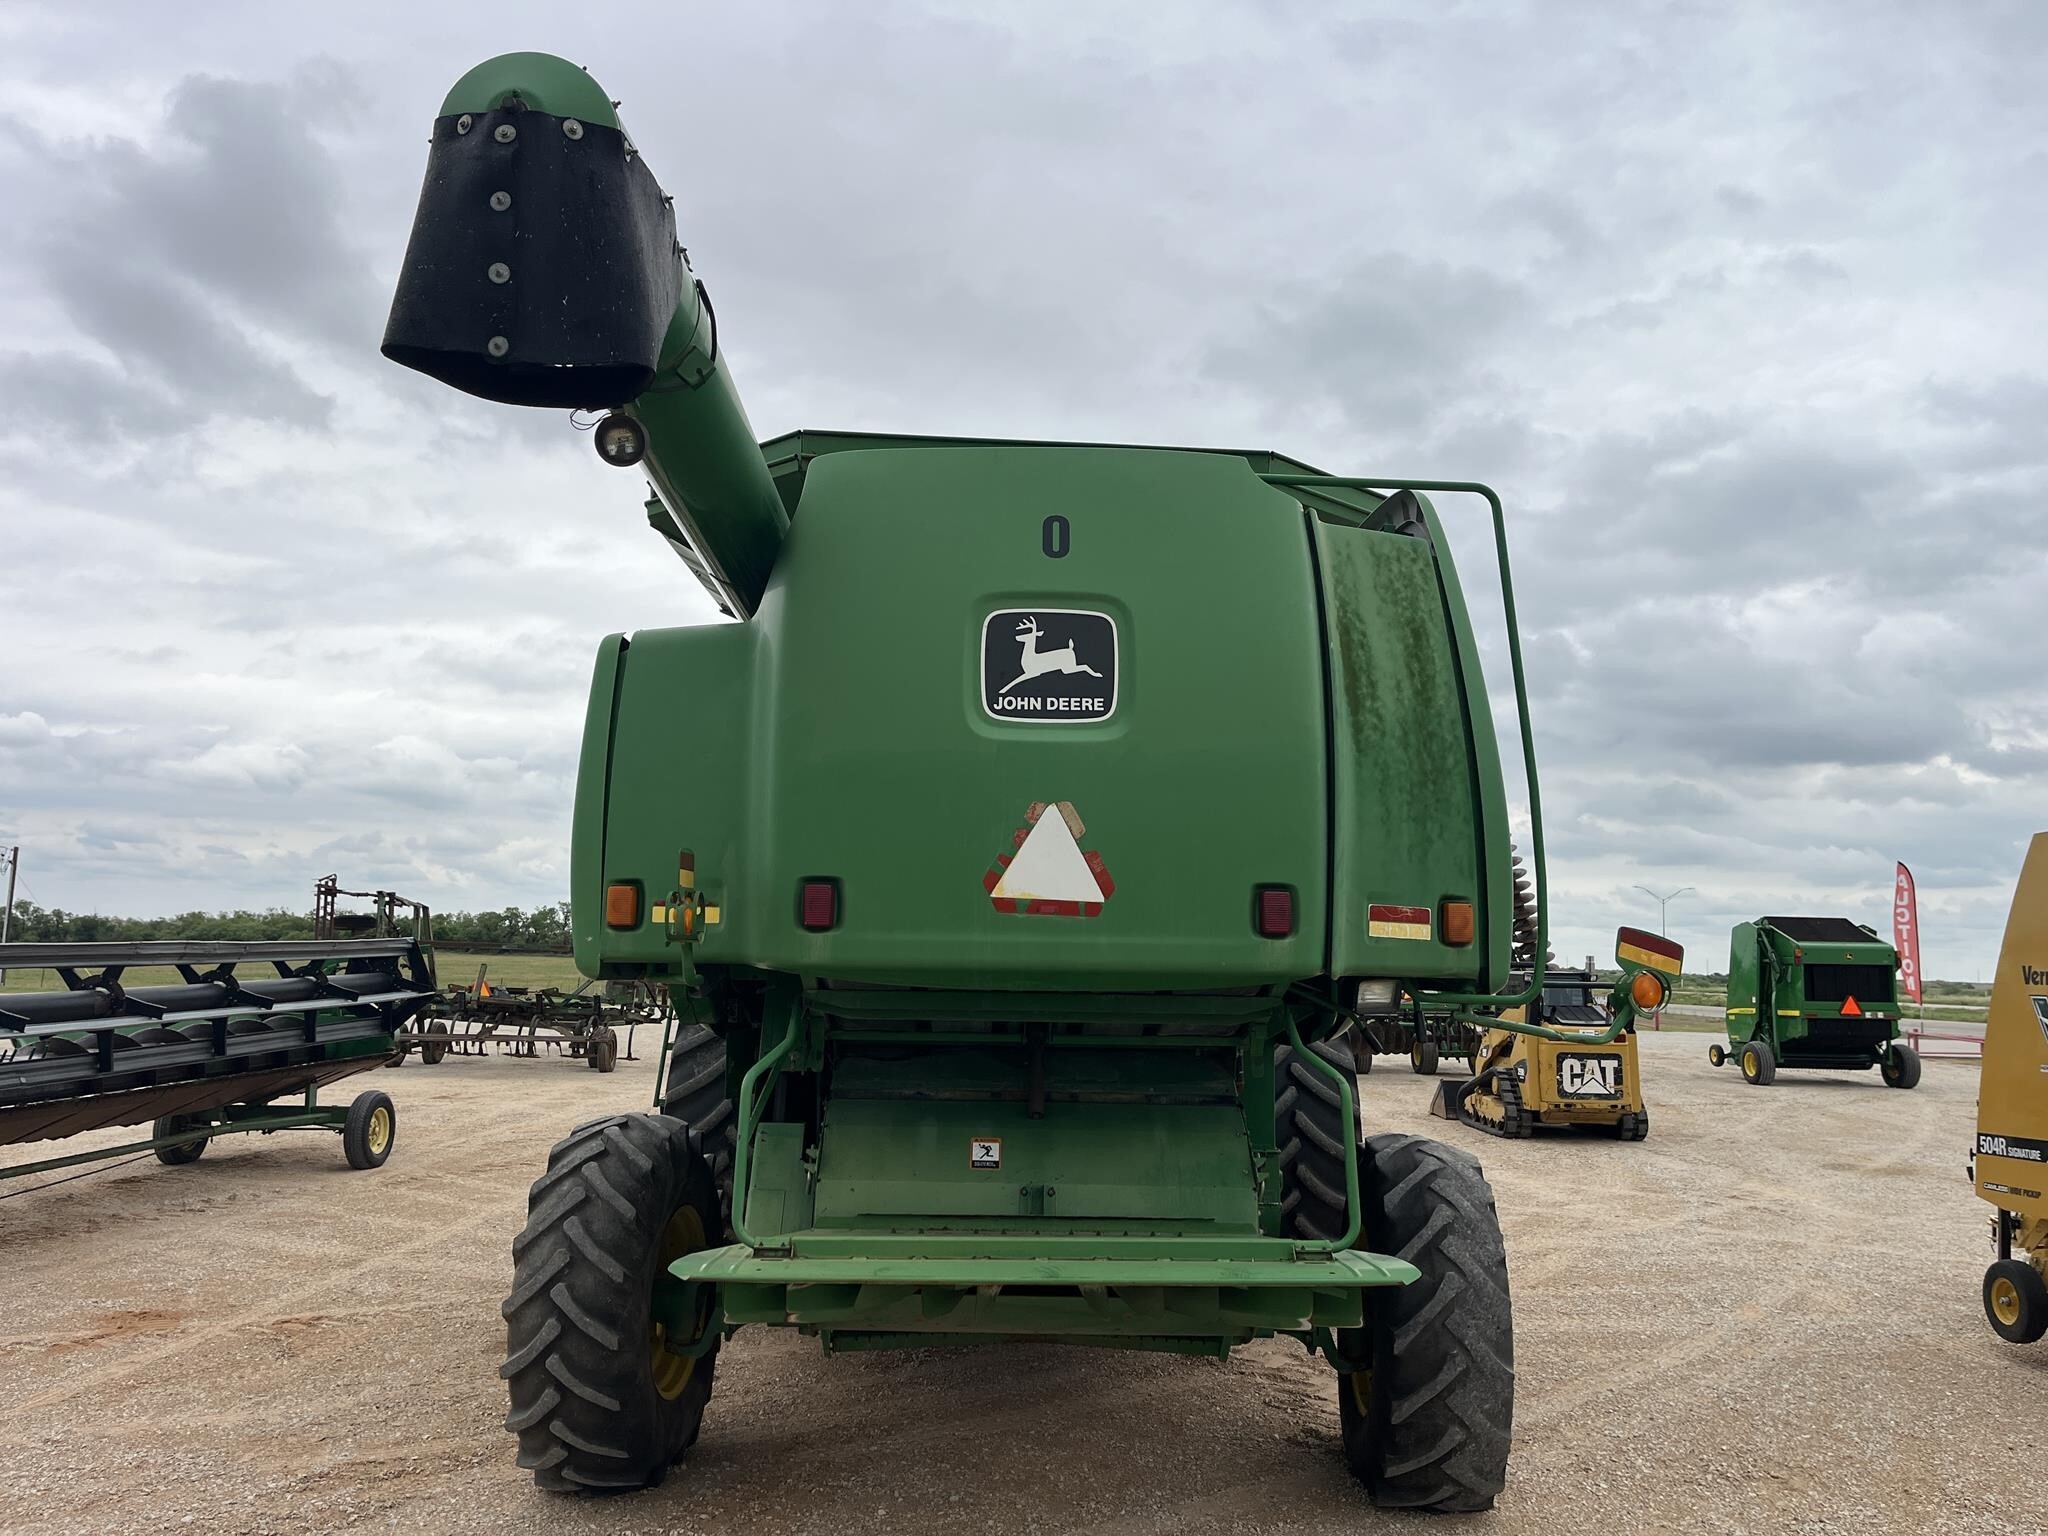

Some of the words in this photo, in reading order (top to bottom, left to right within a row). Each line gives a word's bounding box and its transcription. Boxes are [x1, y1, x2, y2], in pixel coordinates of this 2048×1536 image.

[993, 696, 1042, 710] JOHN
[1046, 697, 1104, 711] DEERE
[1562, 1058, 1618, 1094] CAT
[1980, 1135, 2007, 1156] 504R
[2007, 1146, 2042, 1160] SIGNATURE
